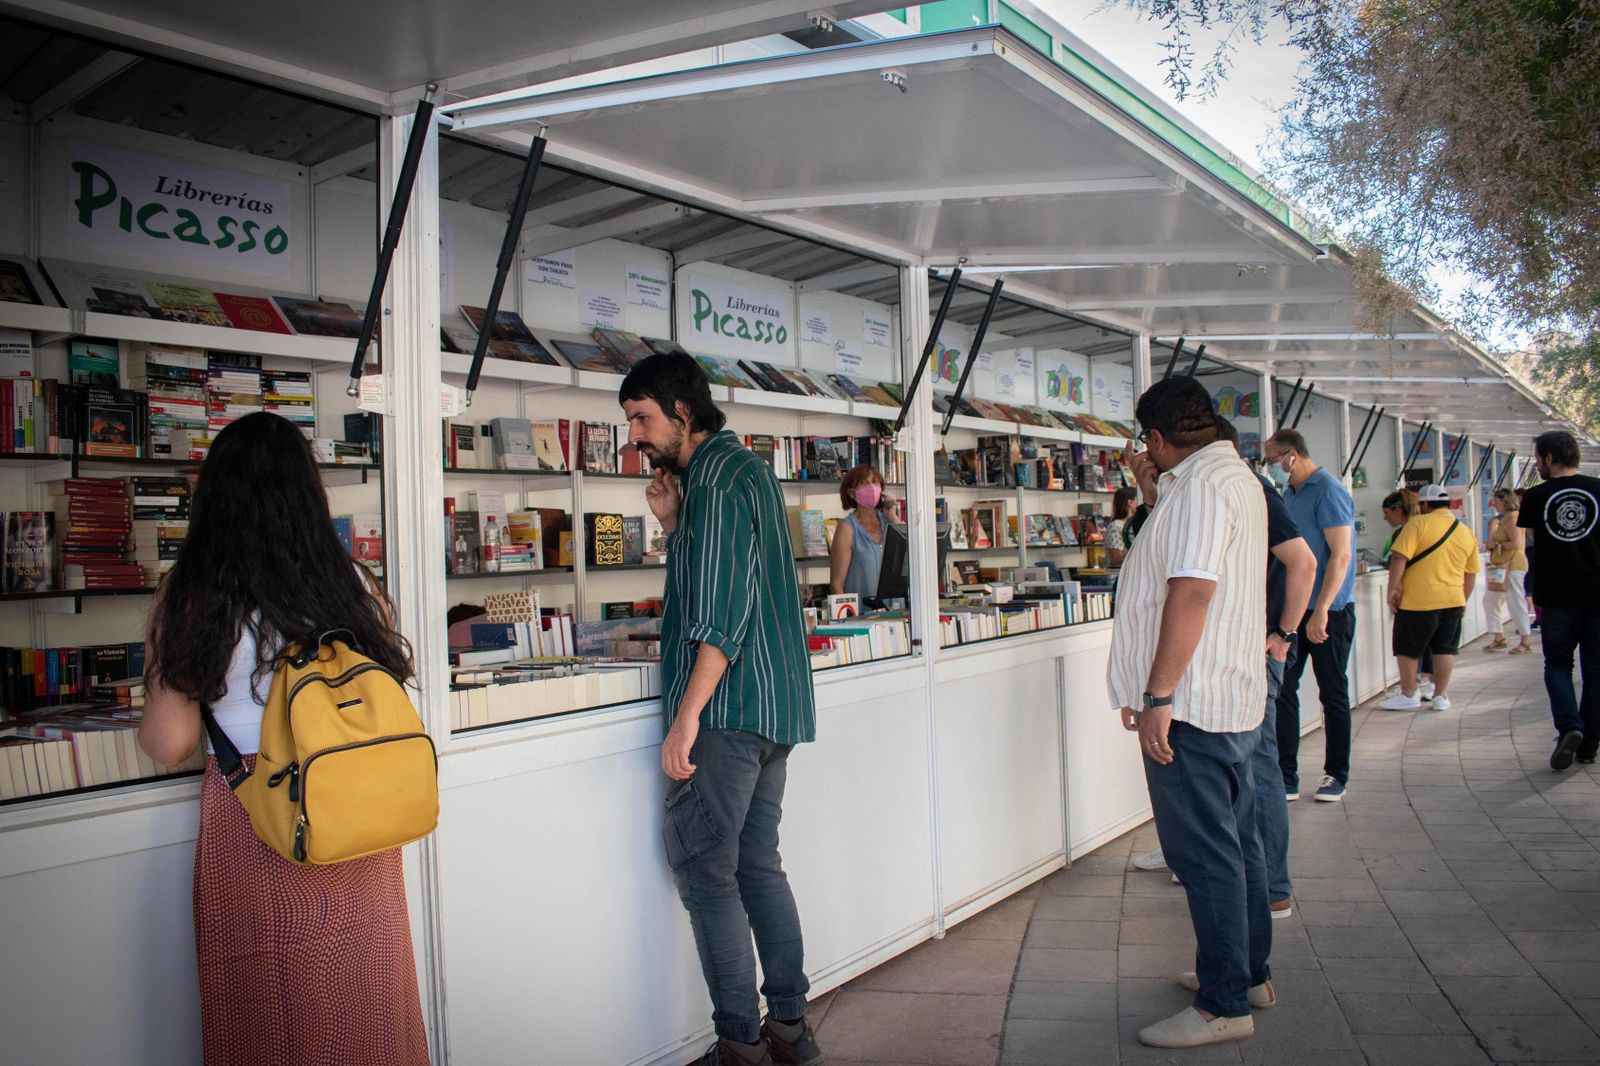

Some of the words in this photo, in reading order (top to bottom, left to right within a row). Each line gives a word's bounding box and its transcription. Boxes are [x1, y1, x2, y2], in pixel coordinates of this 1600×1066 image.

[71, 160, 289, 255] Picasso
[154, 175, 274, 215] Librerías
[550, 267, 568, 276] TARJETA
[641, 275, 667, 286] descuento
[692, 289, 788, 344] Picasso
[727, 296, 780, 318] Librerías
